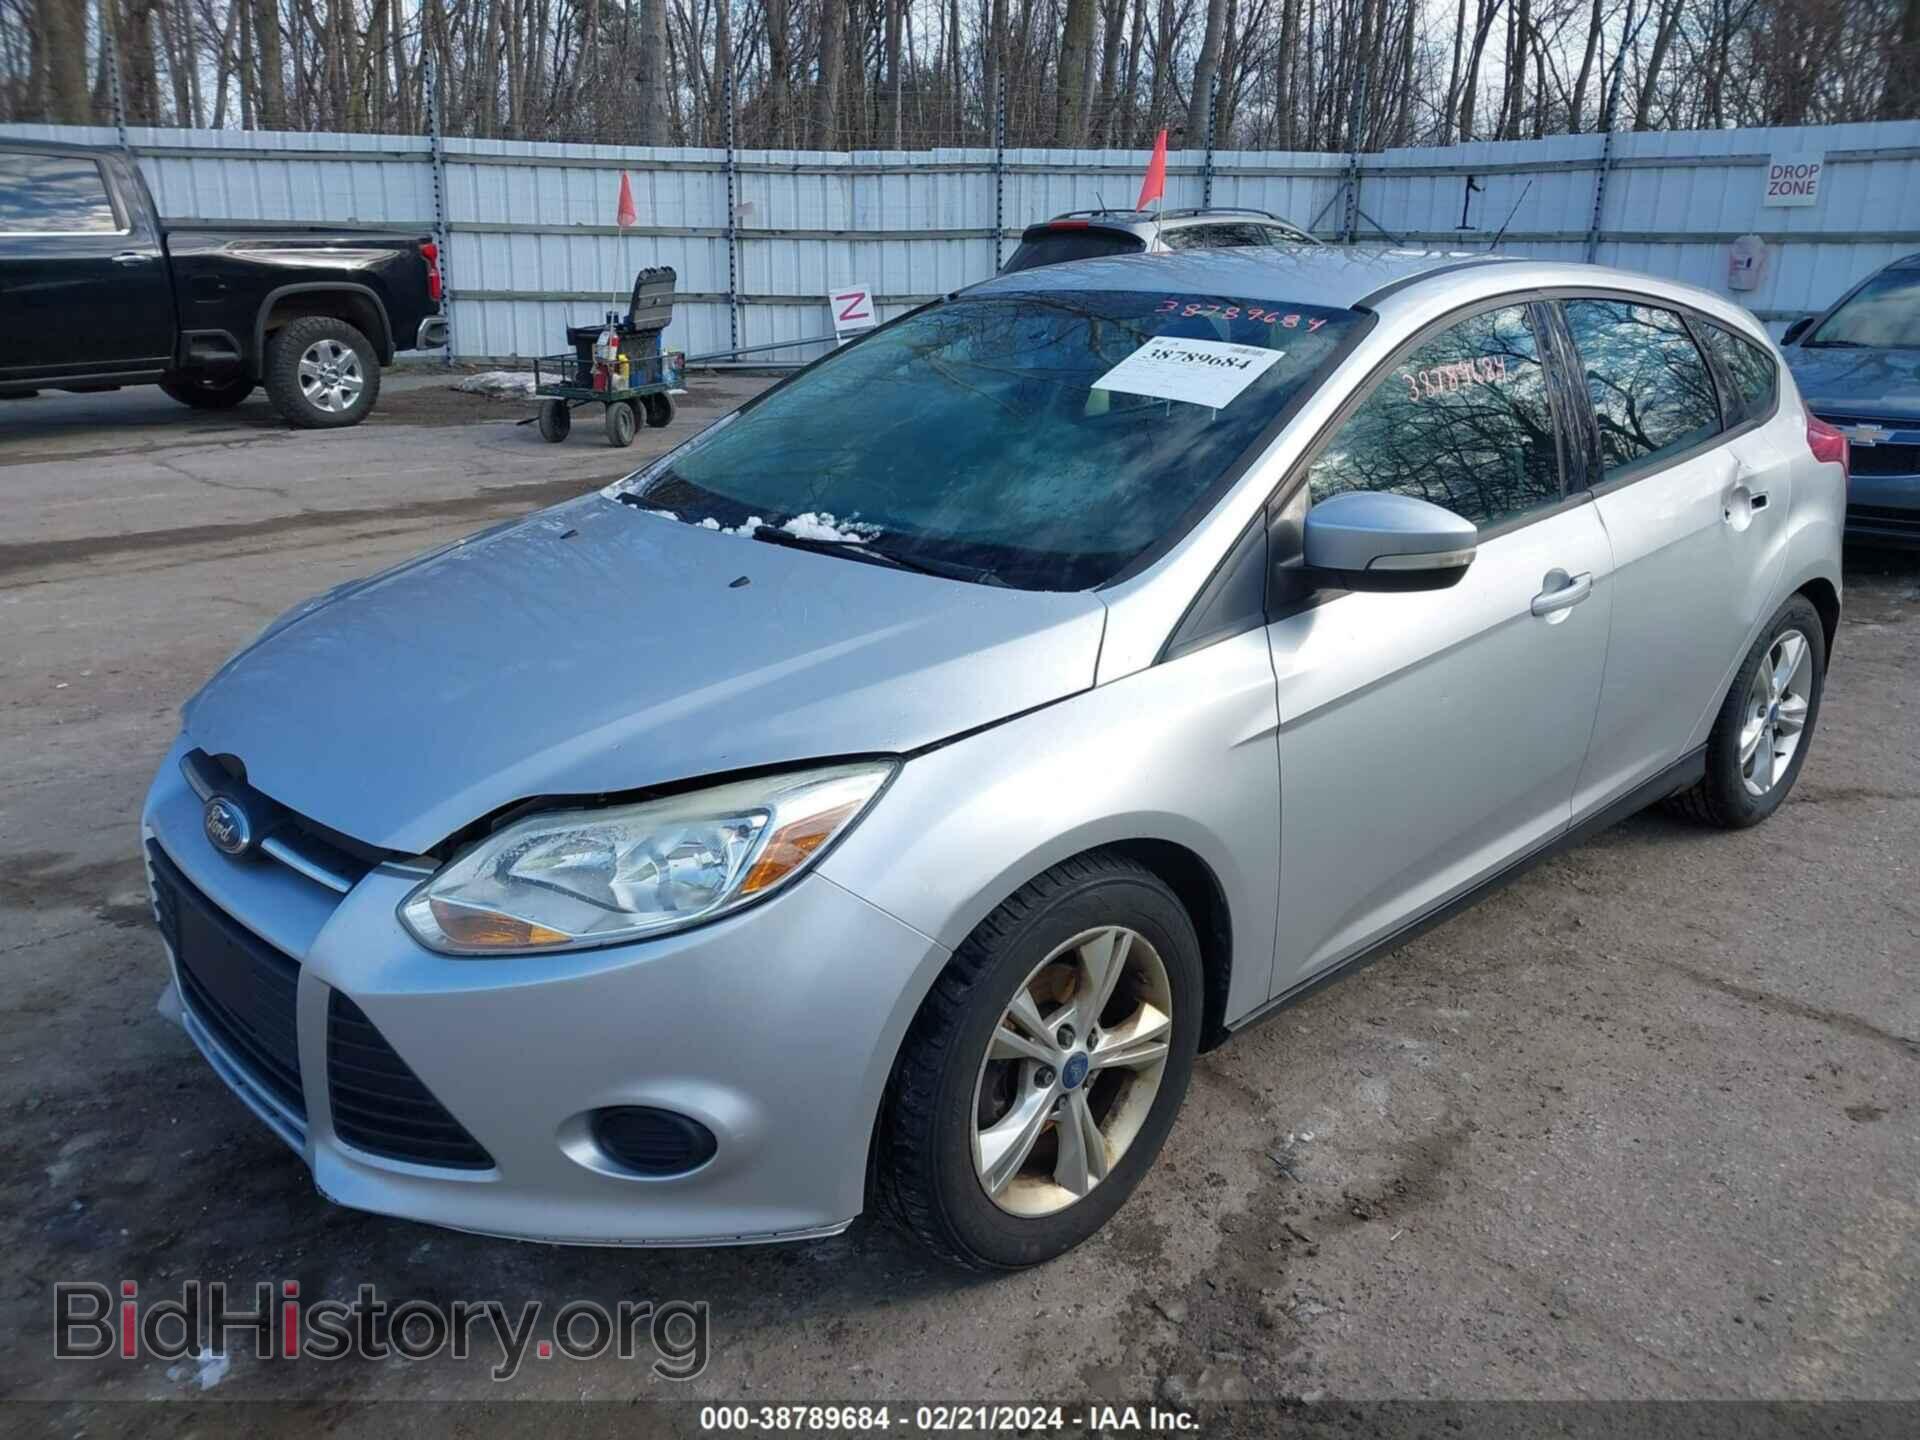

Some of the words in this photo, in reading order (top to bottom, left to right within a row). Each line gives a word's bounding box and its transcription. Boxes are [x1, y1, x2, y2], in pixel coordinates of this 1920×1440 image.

[1770, 164, 1820, 179] DROP
[1768, 181, 1816, 195] ZONE
[1155, 300, 1327, 333] 38789684
[1143, 348, 1253, 371] 38789684
